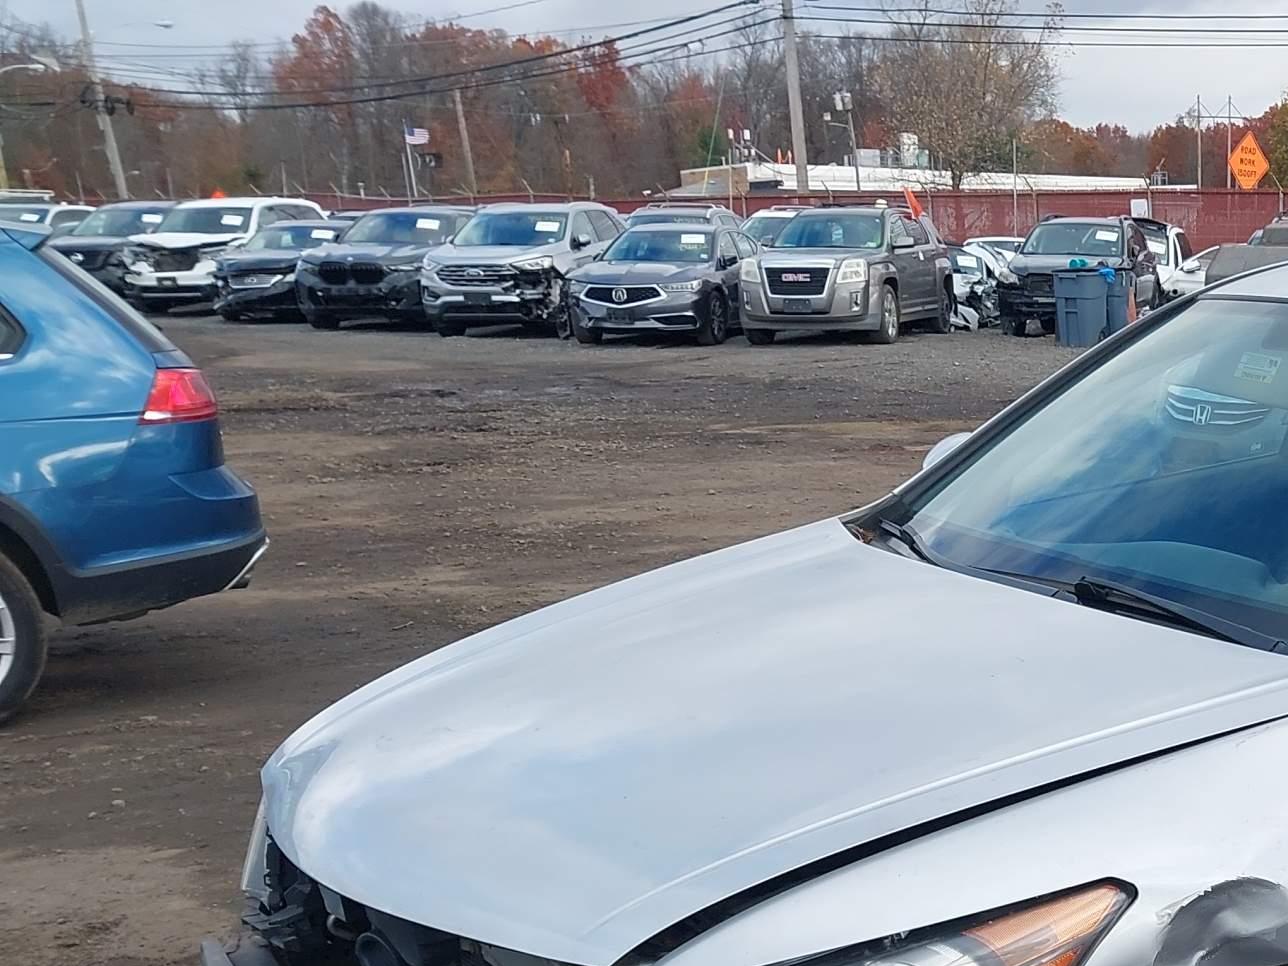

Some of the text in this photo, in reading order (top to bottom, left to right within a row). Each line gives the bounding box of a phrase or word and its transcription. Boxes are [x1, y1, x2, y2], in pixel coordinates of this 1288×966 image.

[1240, 145, 1257, 156] ROAD
[1239, 157, 1256, 167] WORK
[781, 273, 811, 282] GMC
